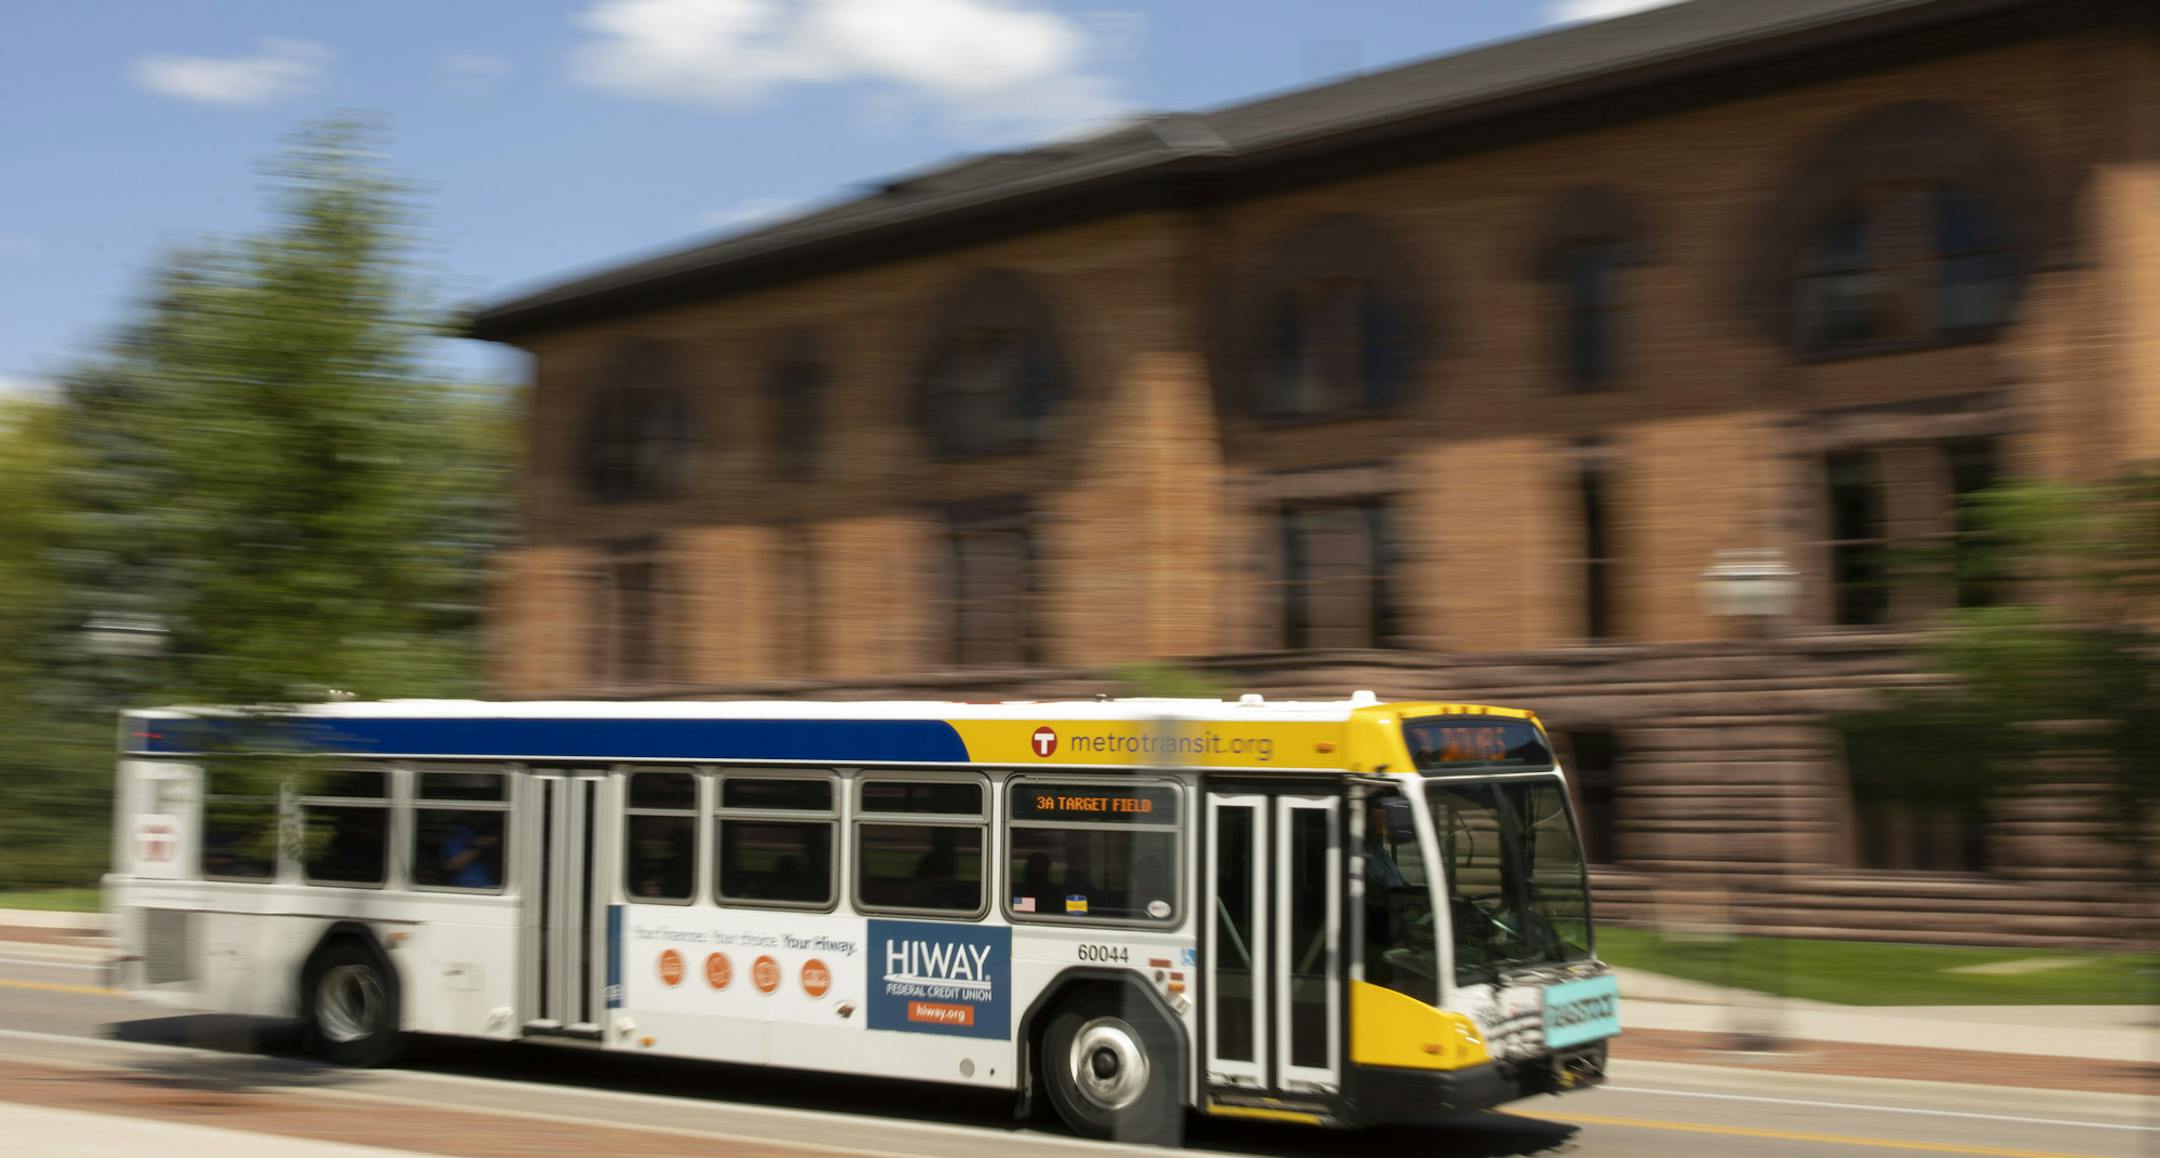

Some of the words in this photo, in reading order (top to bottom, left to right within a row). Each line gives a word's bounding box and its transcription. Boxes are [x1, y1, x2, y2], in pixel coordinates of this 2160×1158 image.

[1070, 731, 1274, 761] metrotransit.org
[1036, 796, 1055, 810] 3A
[1058, 797, 1107, 812] TARGET
[1112, 798, 1152, 813] FIELD
[782, 933, 811, 949] Your
[1078, 944, 1129, 963] 60044
[885, 983, 926, 998] FEDERAL
[927, 985, 961, 1000] CREDIT
[962, 989, 992, 1003] UNION
[915, 1004, 965, 1023] hiway.org
